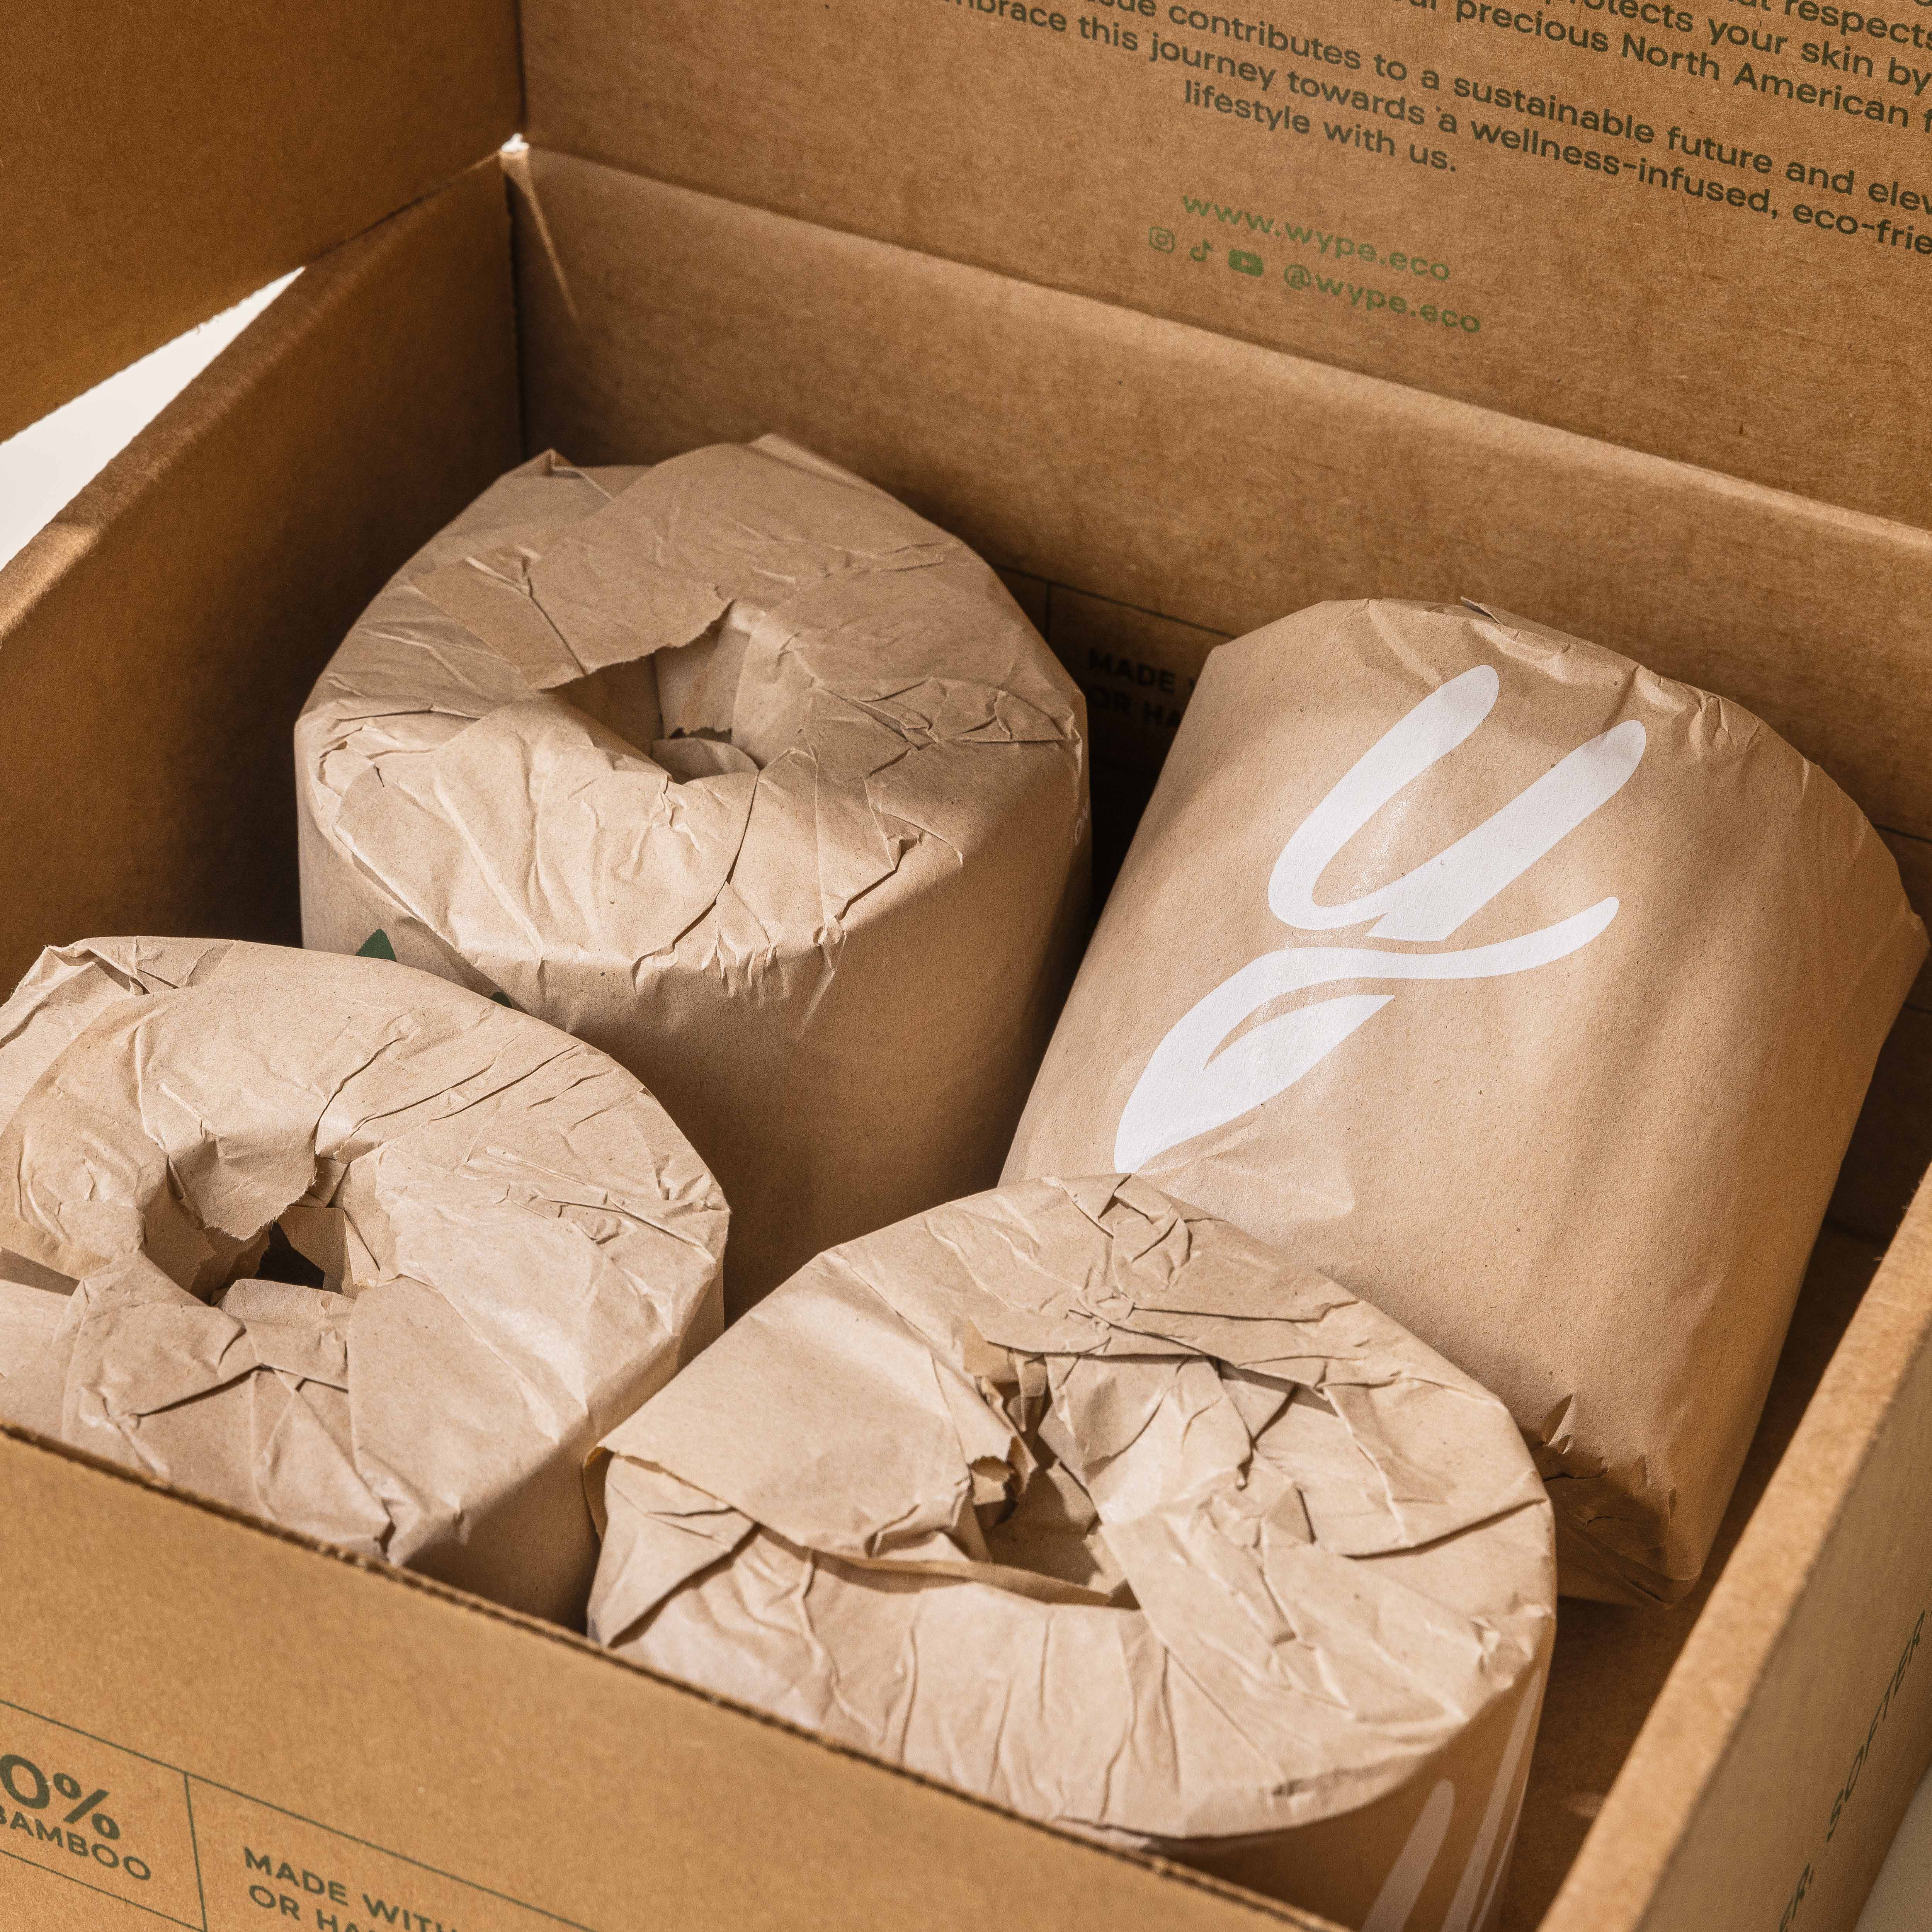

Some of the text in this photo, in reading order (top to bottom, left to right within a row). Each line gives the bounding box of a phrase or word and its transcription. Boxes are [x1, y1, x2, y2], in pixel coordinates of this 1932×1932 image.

[1456, 0, 1608, 52] precious
[1622, 33, 1719, 81] North
[1733, 63, 1908, 128] American
[1708, 19, 1788, 54] your
[1801, 41, 1873, 77] skin
[1888, 58, 1932, 95] by
[1078, 17, 1138, 51] this
[1150, 32, 1275, 91] journey
[1287, 71, 1424, 125] towards
[1437, 111, 1457, 134] a
[1471, 121, 1777, 219] wellness-infused,
[1793, 204, 1932, 255] eco-frie
[1169, 6, 1361, 69] contributes
[1374, 54, 1407, 81] to
[1421, 70, 1439, 90] a
[1454, 78, 1654, 143] sustainable
[1668, 126, 1772, 173] future
[1786, 162, 1854, 195] and
[1185, 80, 1456, 172] lifestyle with us.
[1182, 195, 1450, 282] www.wype.eco
[1284, 264, 1481, 334] @wype.eco
[1088, 649, 1175, 693] MADE
[1826, 1609, 1926, 1842] SOFTER
[0, 1805, 151, 1880] AMBOO
[244, 1846, 348, 1906] MADE
[249, 1884, 300, 1920] OR
